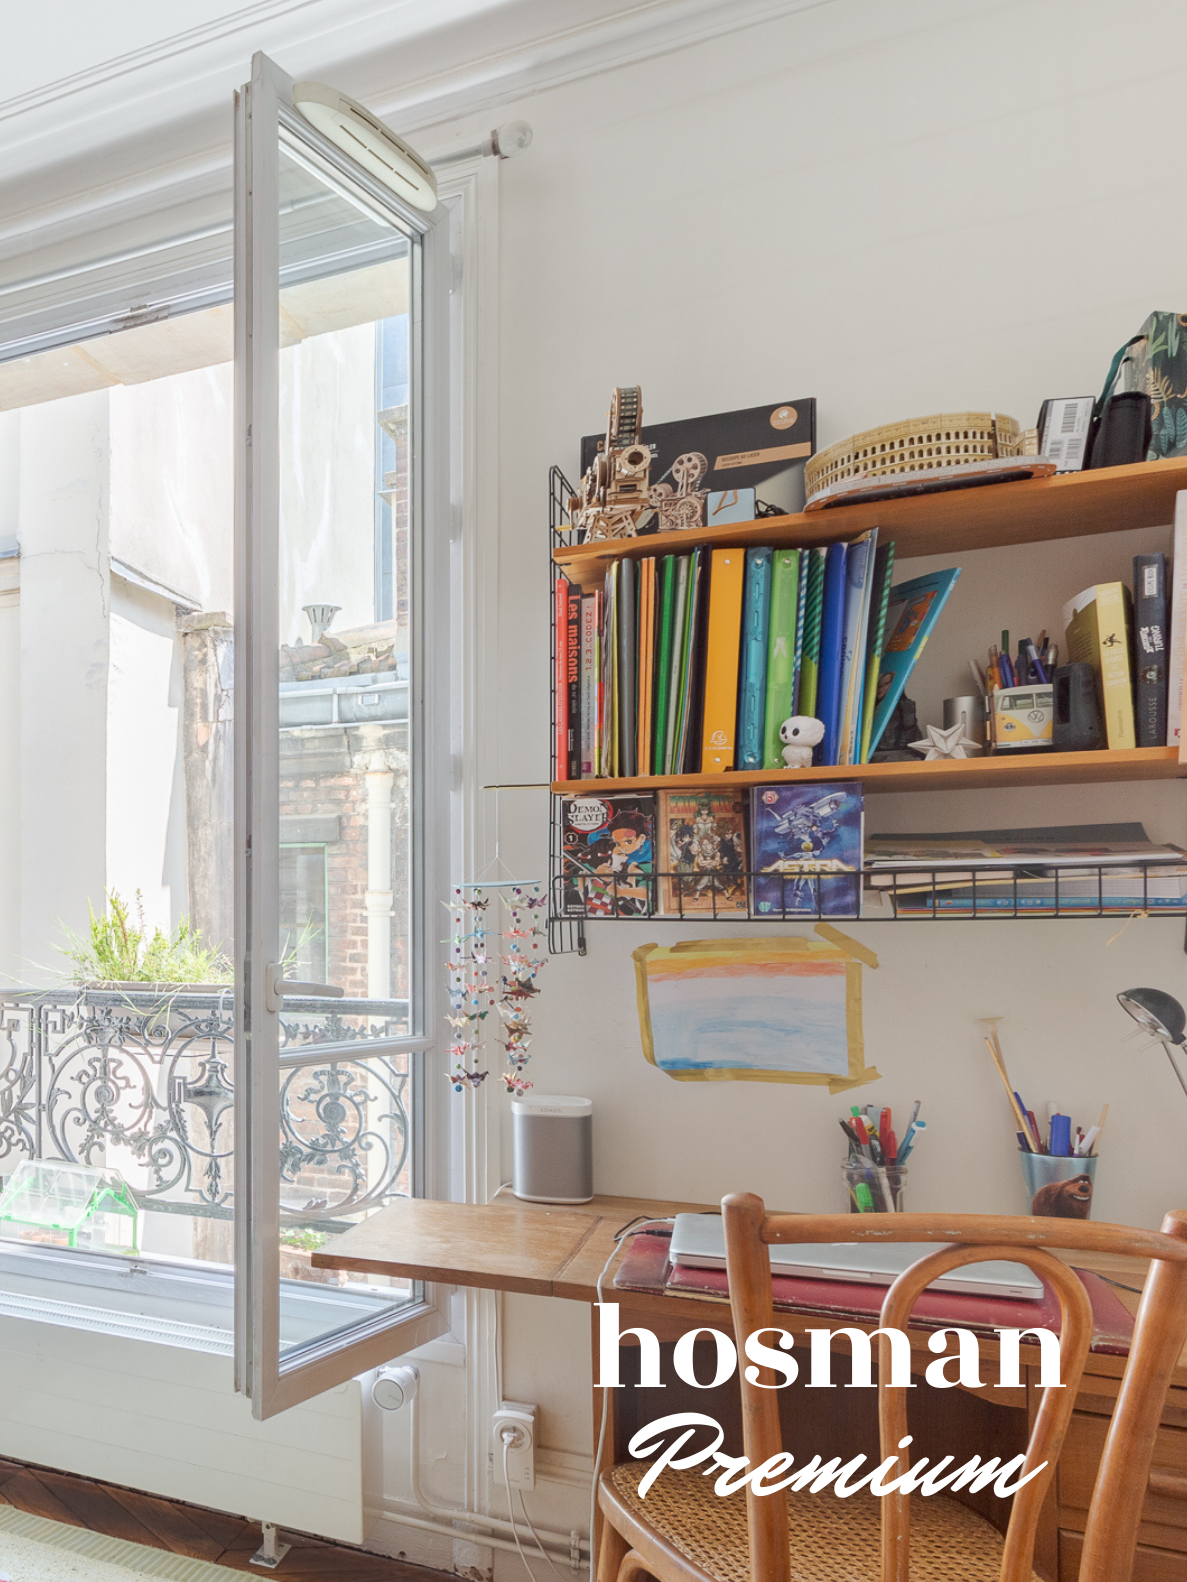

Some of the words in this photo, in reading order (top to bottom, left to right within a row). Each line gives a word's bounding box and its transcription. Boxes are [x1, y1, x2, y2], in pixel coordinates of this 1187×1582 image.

[568, 594, 580, 620] Les
[1150, 625, 1164, 651] TURING
[568, 624, 580, 683] maisons
[1148, 697, 1157, 740] LAROUSSE
[568, 812, 610, 825] SLAYER
[760, 859, 856, 872] ASTRA
